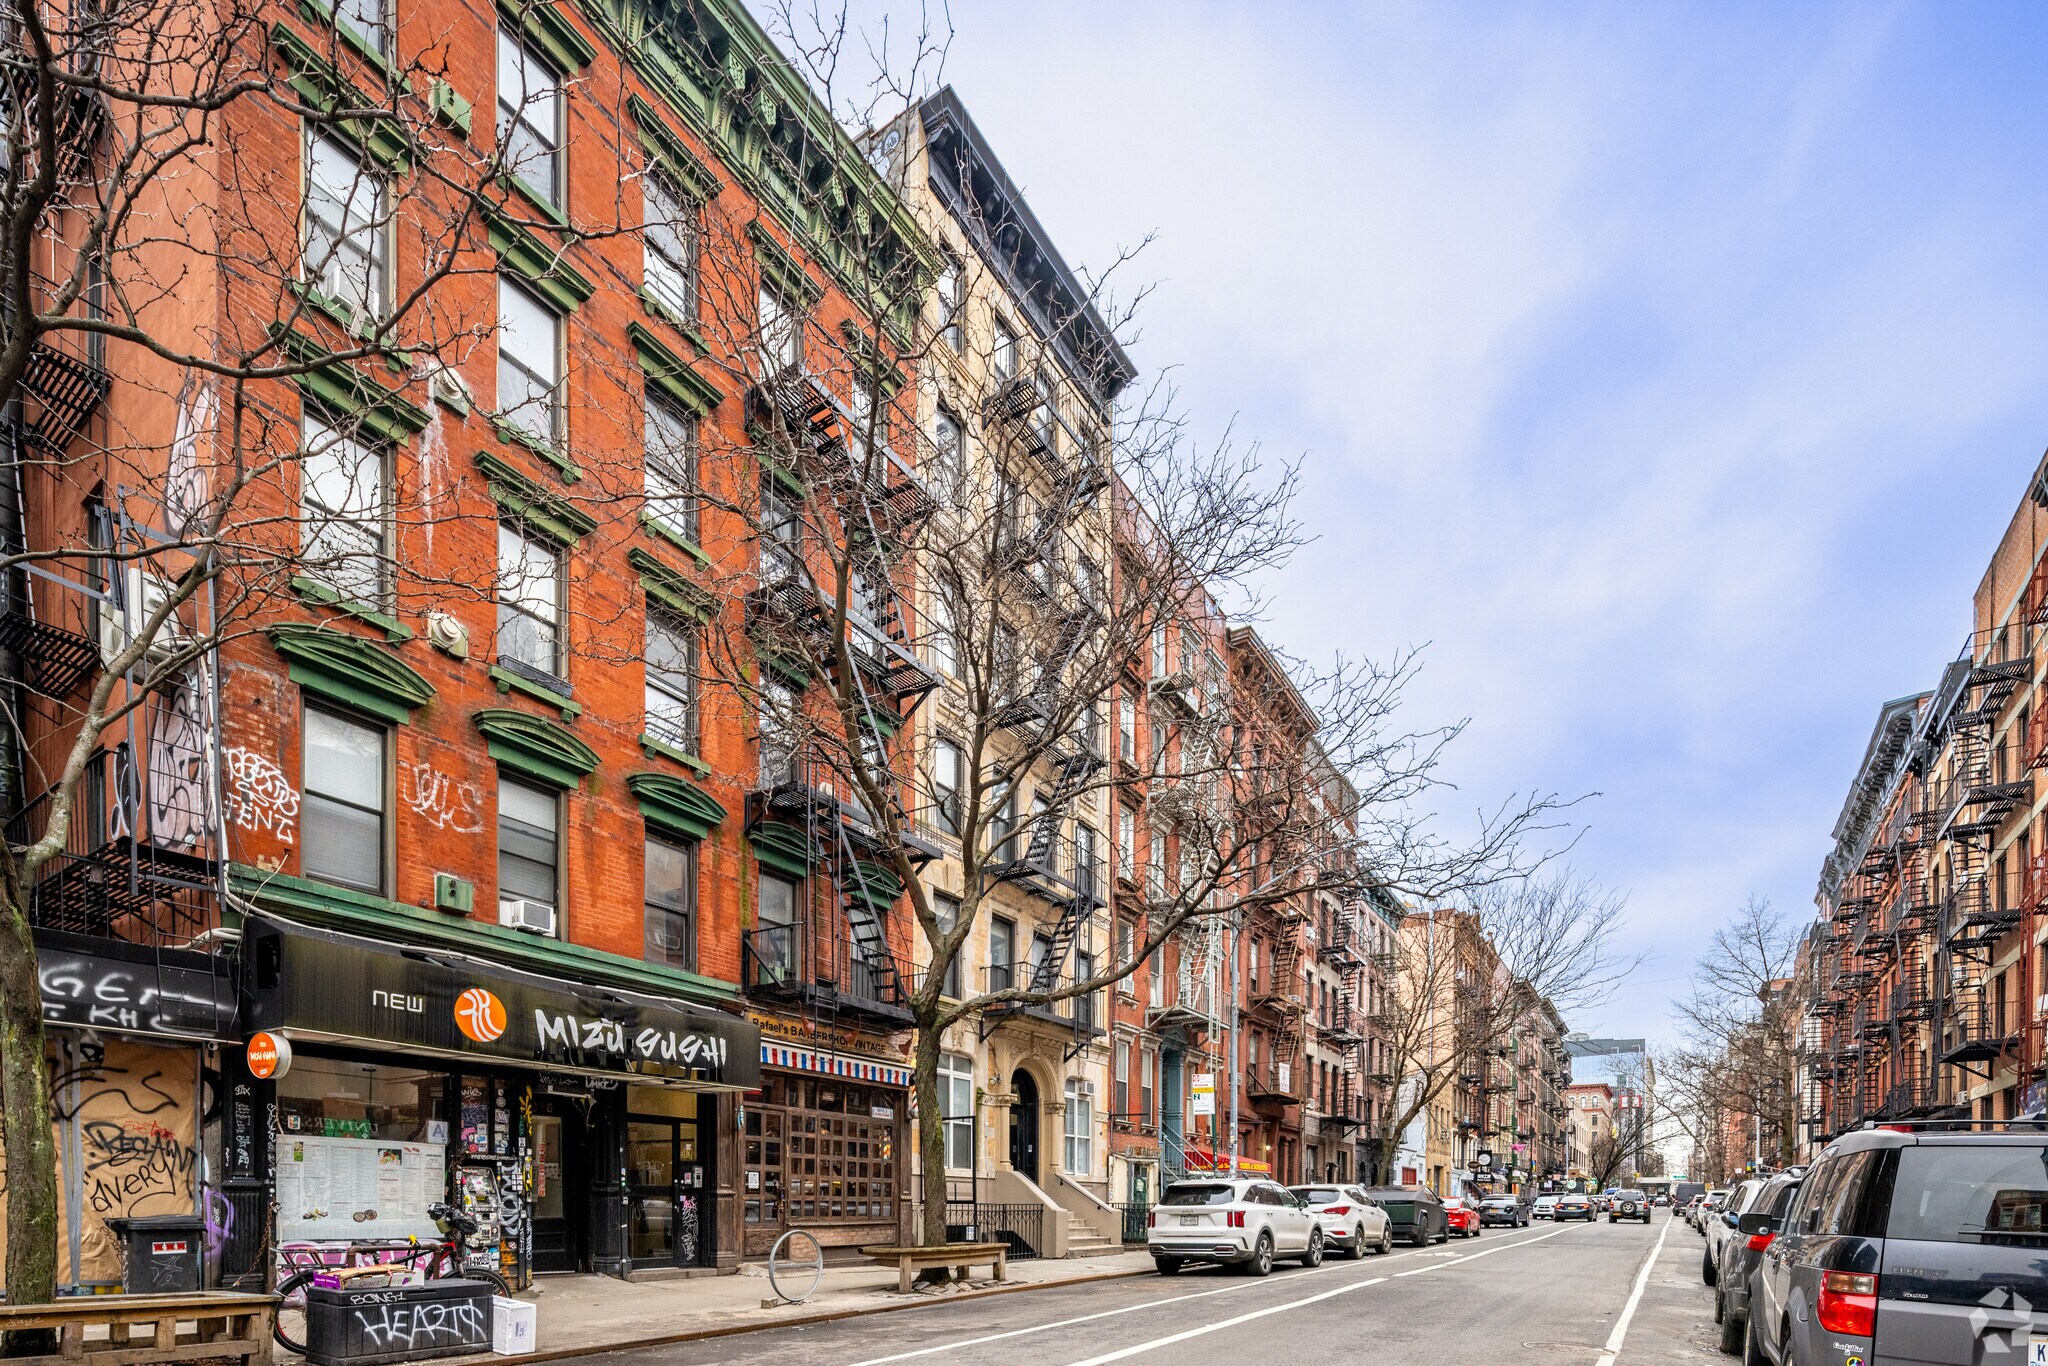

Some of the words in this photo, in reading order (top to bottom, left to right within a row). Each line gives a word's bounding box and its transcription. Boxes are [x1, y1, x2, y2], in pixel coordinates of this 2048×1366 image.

[372, 989, 423, 1013] NEW
[534, 1007, 624, 1053] MIZU
[635, 1026, 727, 1069] SUSHI
[752, 1017, 789, 1034] Rafael's
[790, 1024, 851, 1047] BABERSHO
[431, 1123, 445, 1138] A
